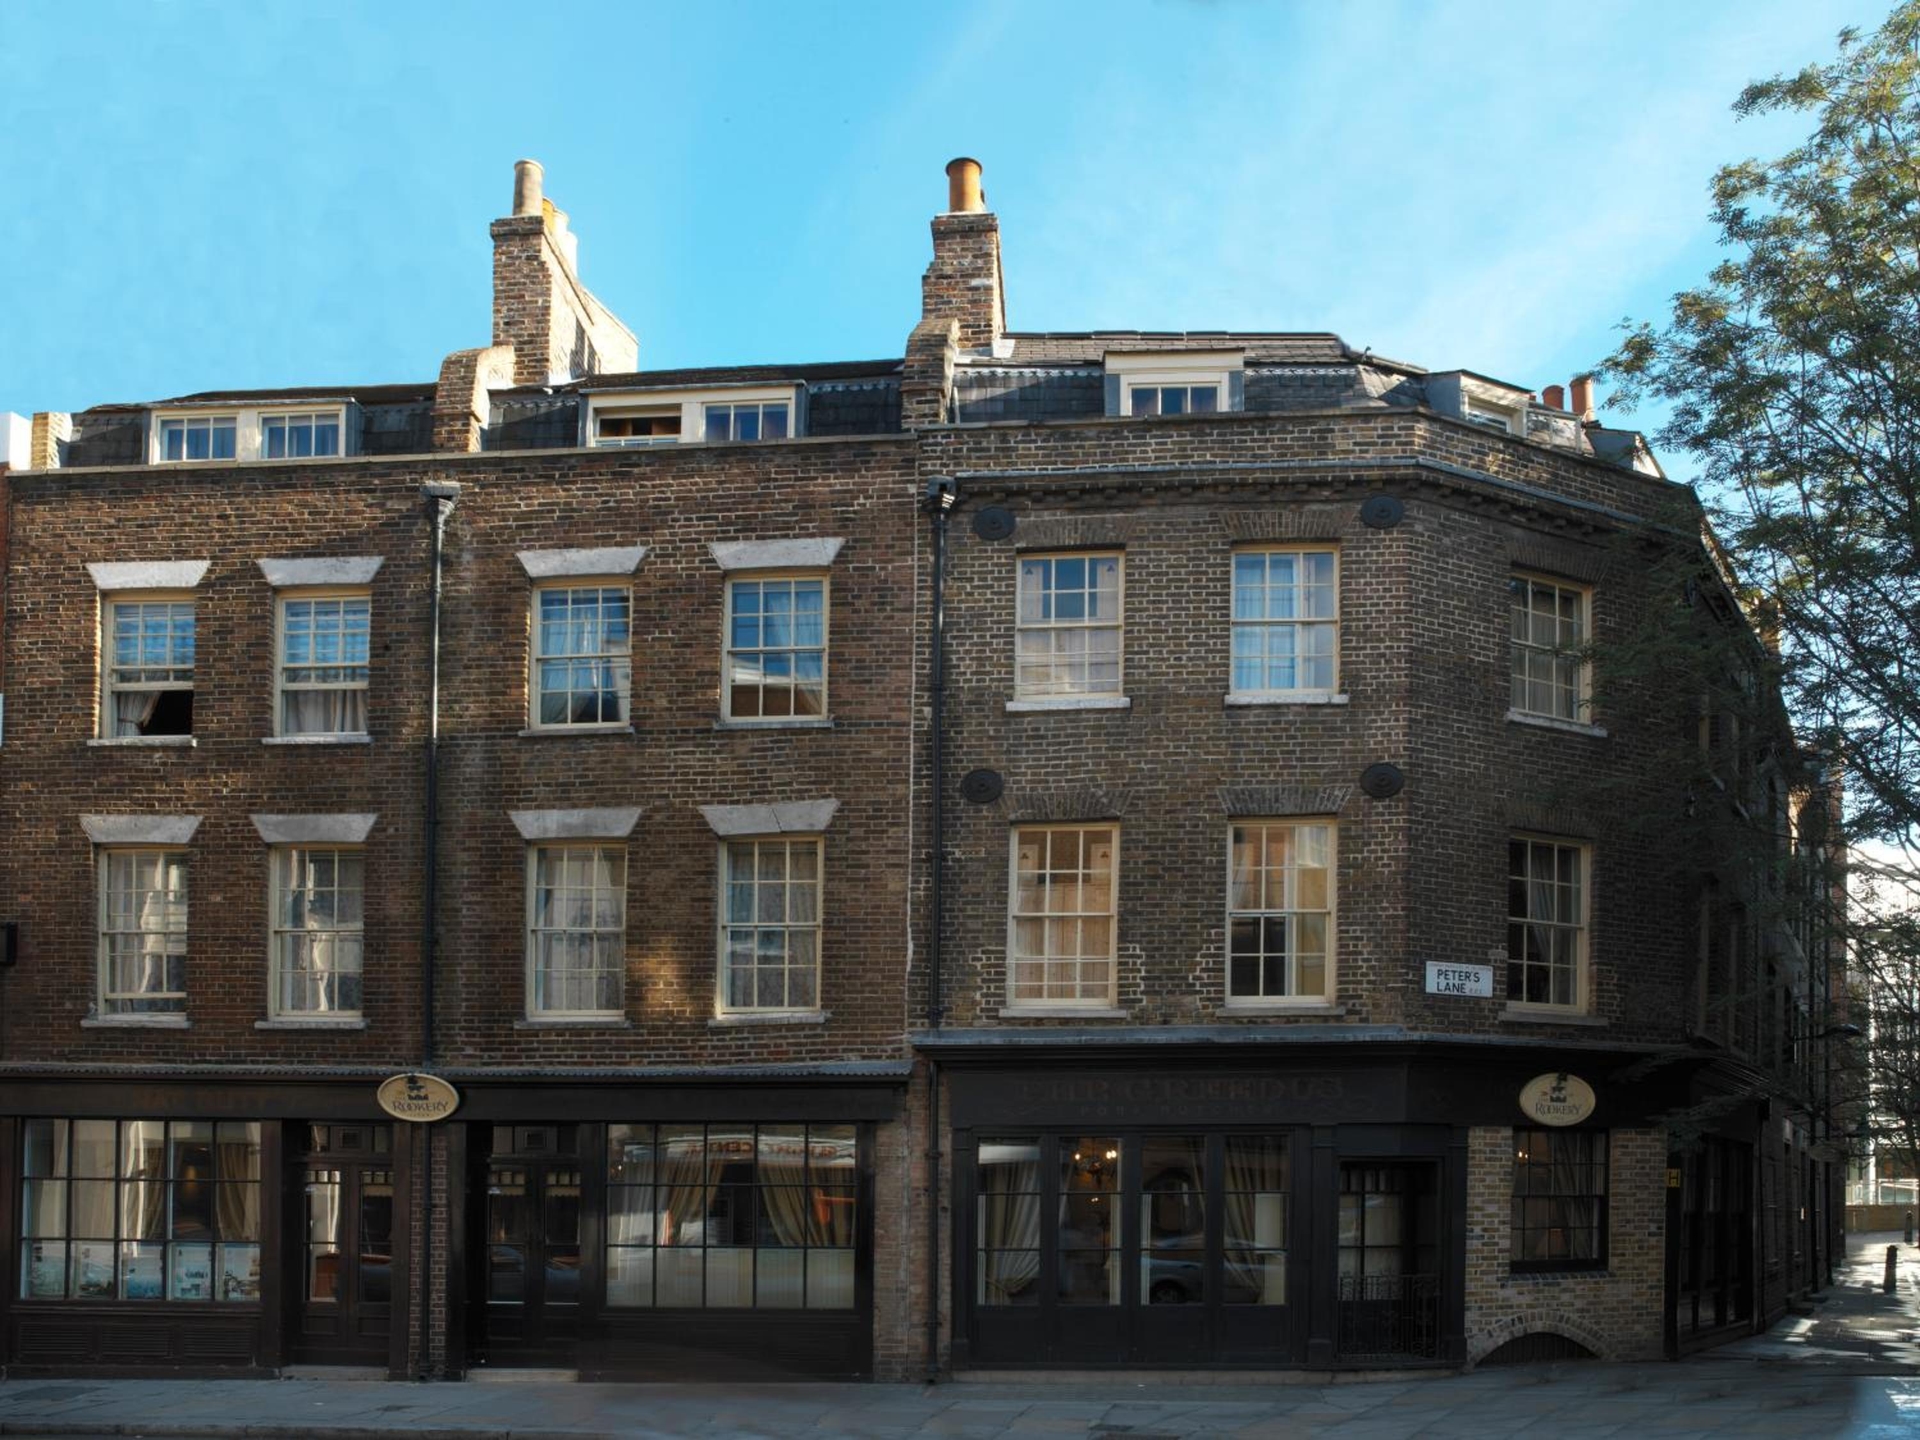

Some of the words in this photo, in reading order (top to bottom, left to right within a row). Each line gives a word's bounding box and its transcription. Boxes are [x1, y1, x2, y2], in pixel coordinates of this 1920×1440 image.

[1436, 981, 1467, 994] LANE
[392, 1101, 449, 1112] ROOKERY
[1535, 1103, 1582, 1115] ROOKERY
